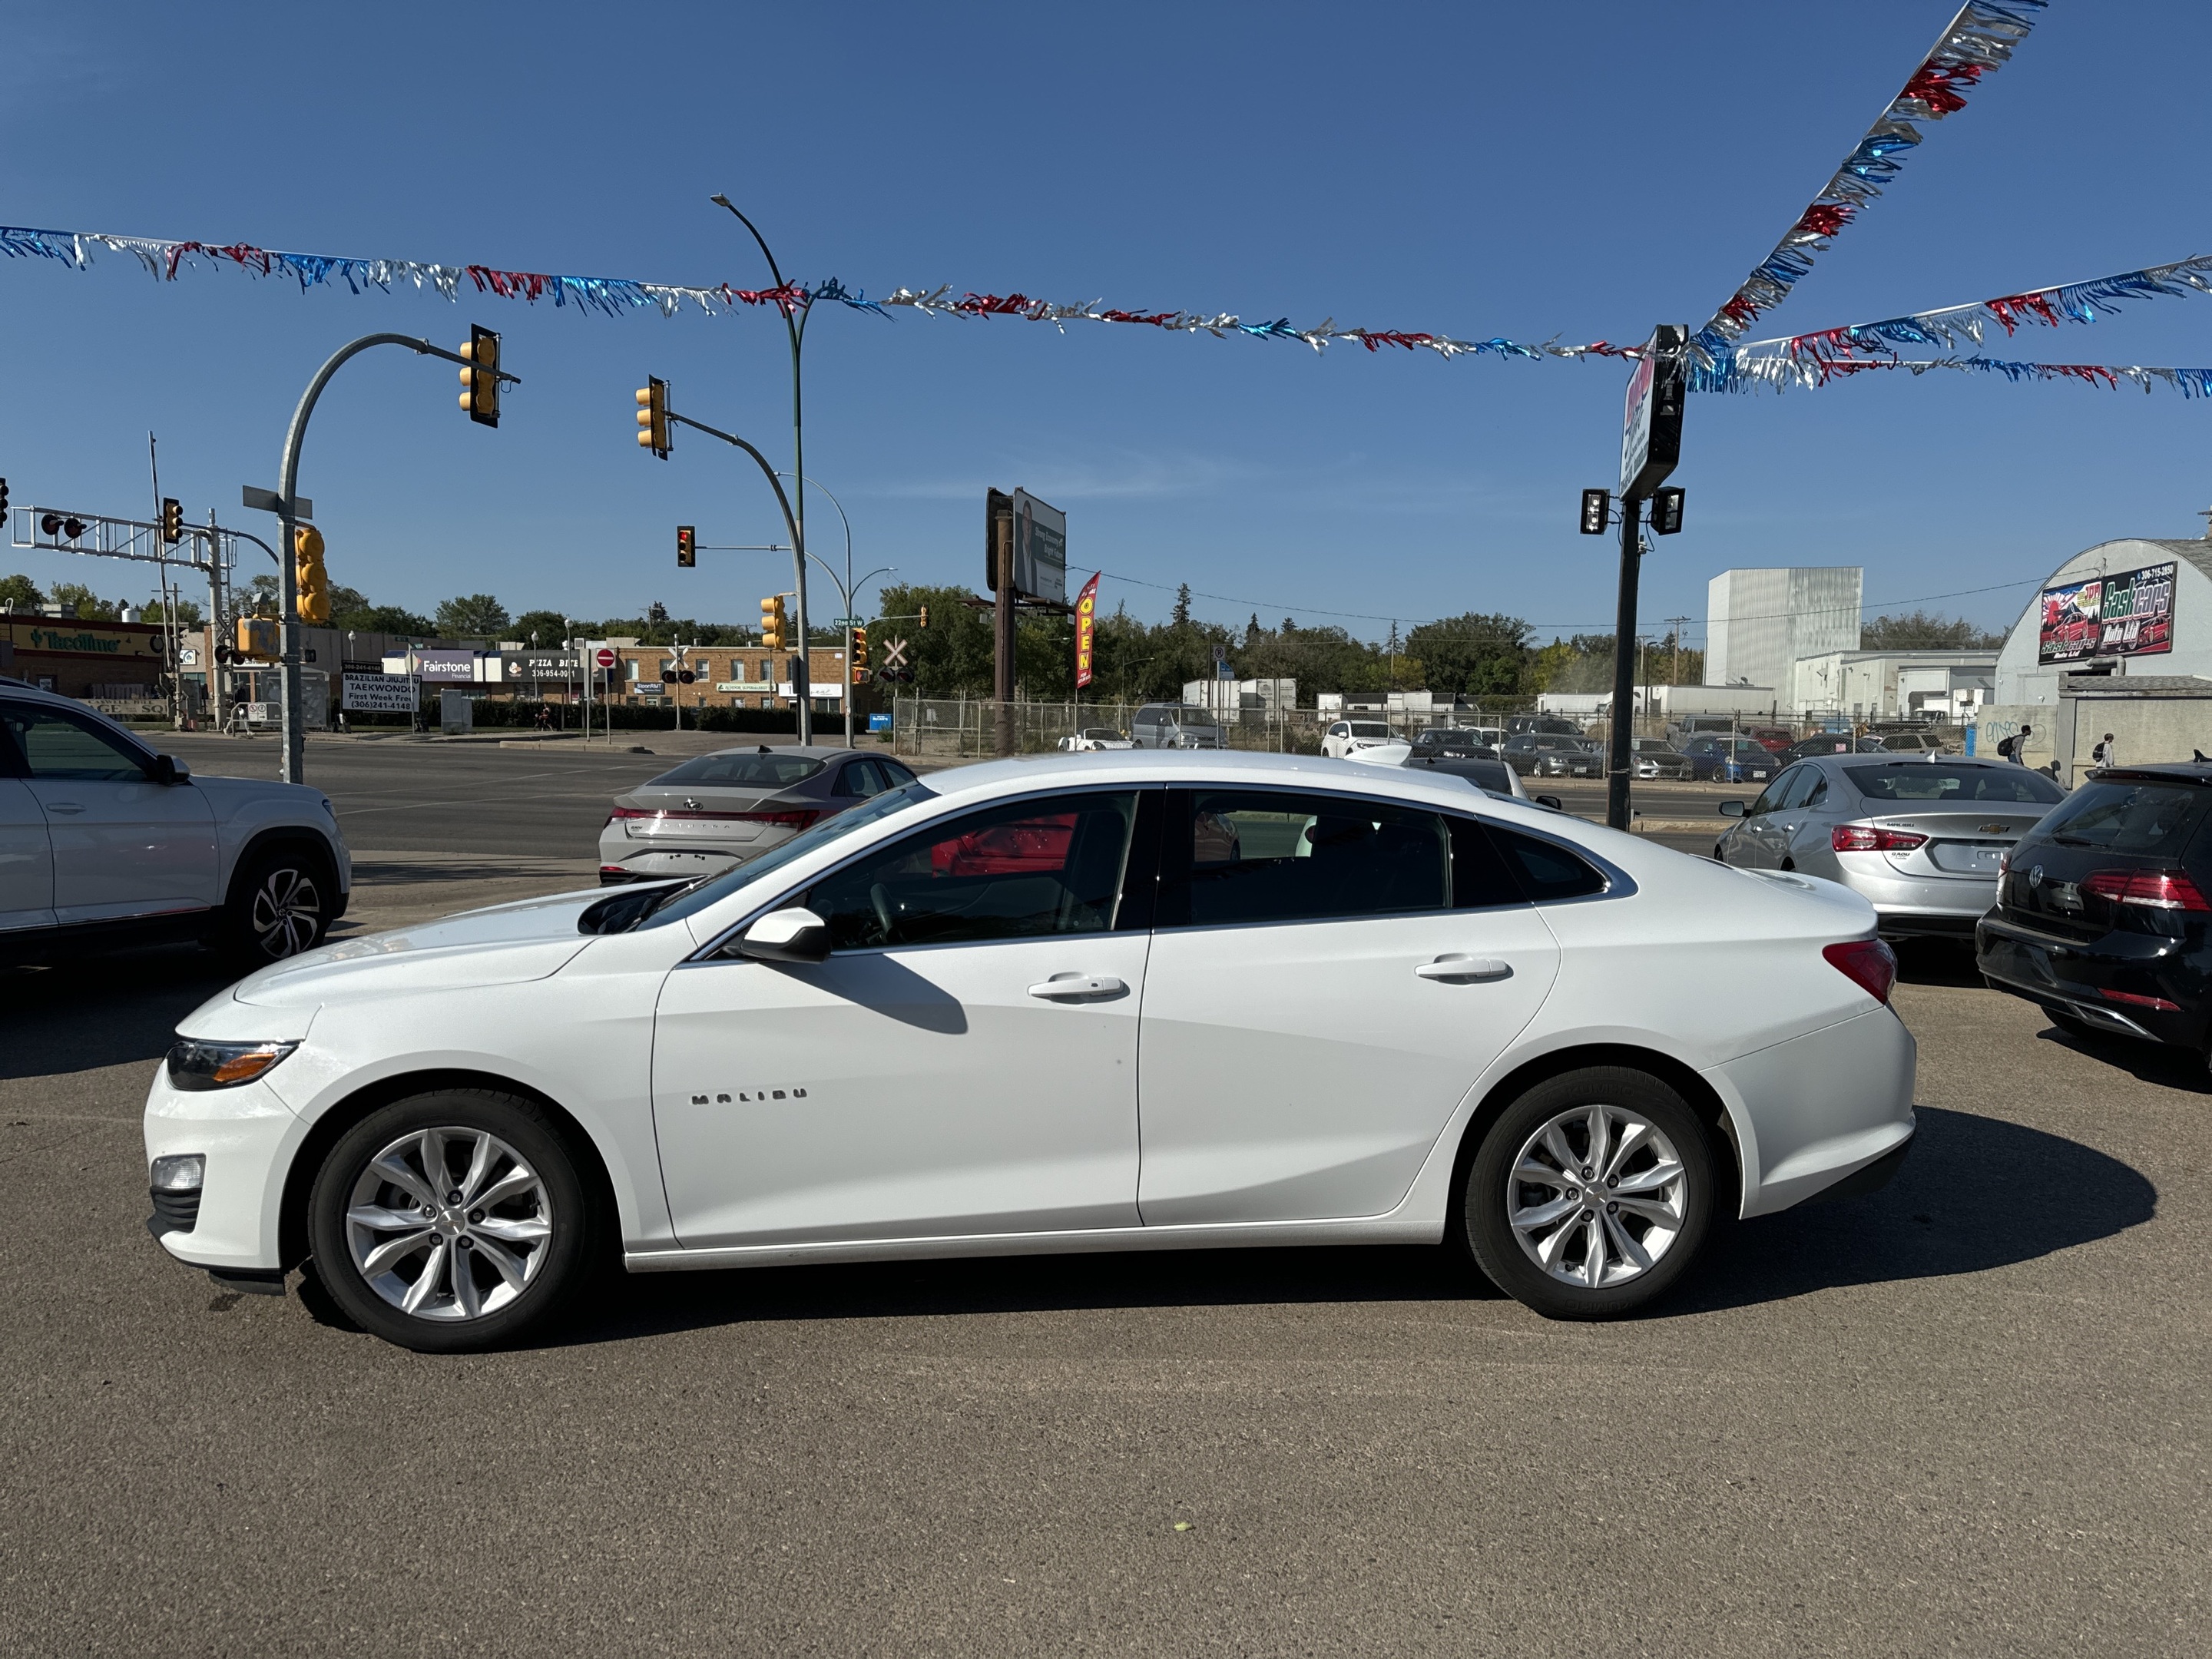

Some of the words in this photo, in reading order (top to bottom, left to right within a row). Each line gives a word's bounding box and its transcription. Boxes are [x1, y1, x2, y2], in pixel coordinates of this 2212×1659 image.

[2141, 565, 2174, 580] 306-715-2850
[2085, 583, 2101, 601] JDM
[2102, 577, 2171, 624] Saskcars
[1079, 597, 1094, 670] OPEN
[2103, 625, 2123, 645] Auto
[2123, 620, 2141, 643] Ltd
[43, 631, 119, 652] TacoTime
[2041, 637, 2096, 654] Saskcars
[423, 660, 471, 672] Fairstone
[345, 674, 384, 683] BRAZILIAN
[349, 683, 416, 694] TAEKWONDO
[369, 693, 392, 701] Week
[351, 701, 411, 710] (306)241-4148
[691, 1088, 807, 1105] MALIBU
